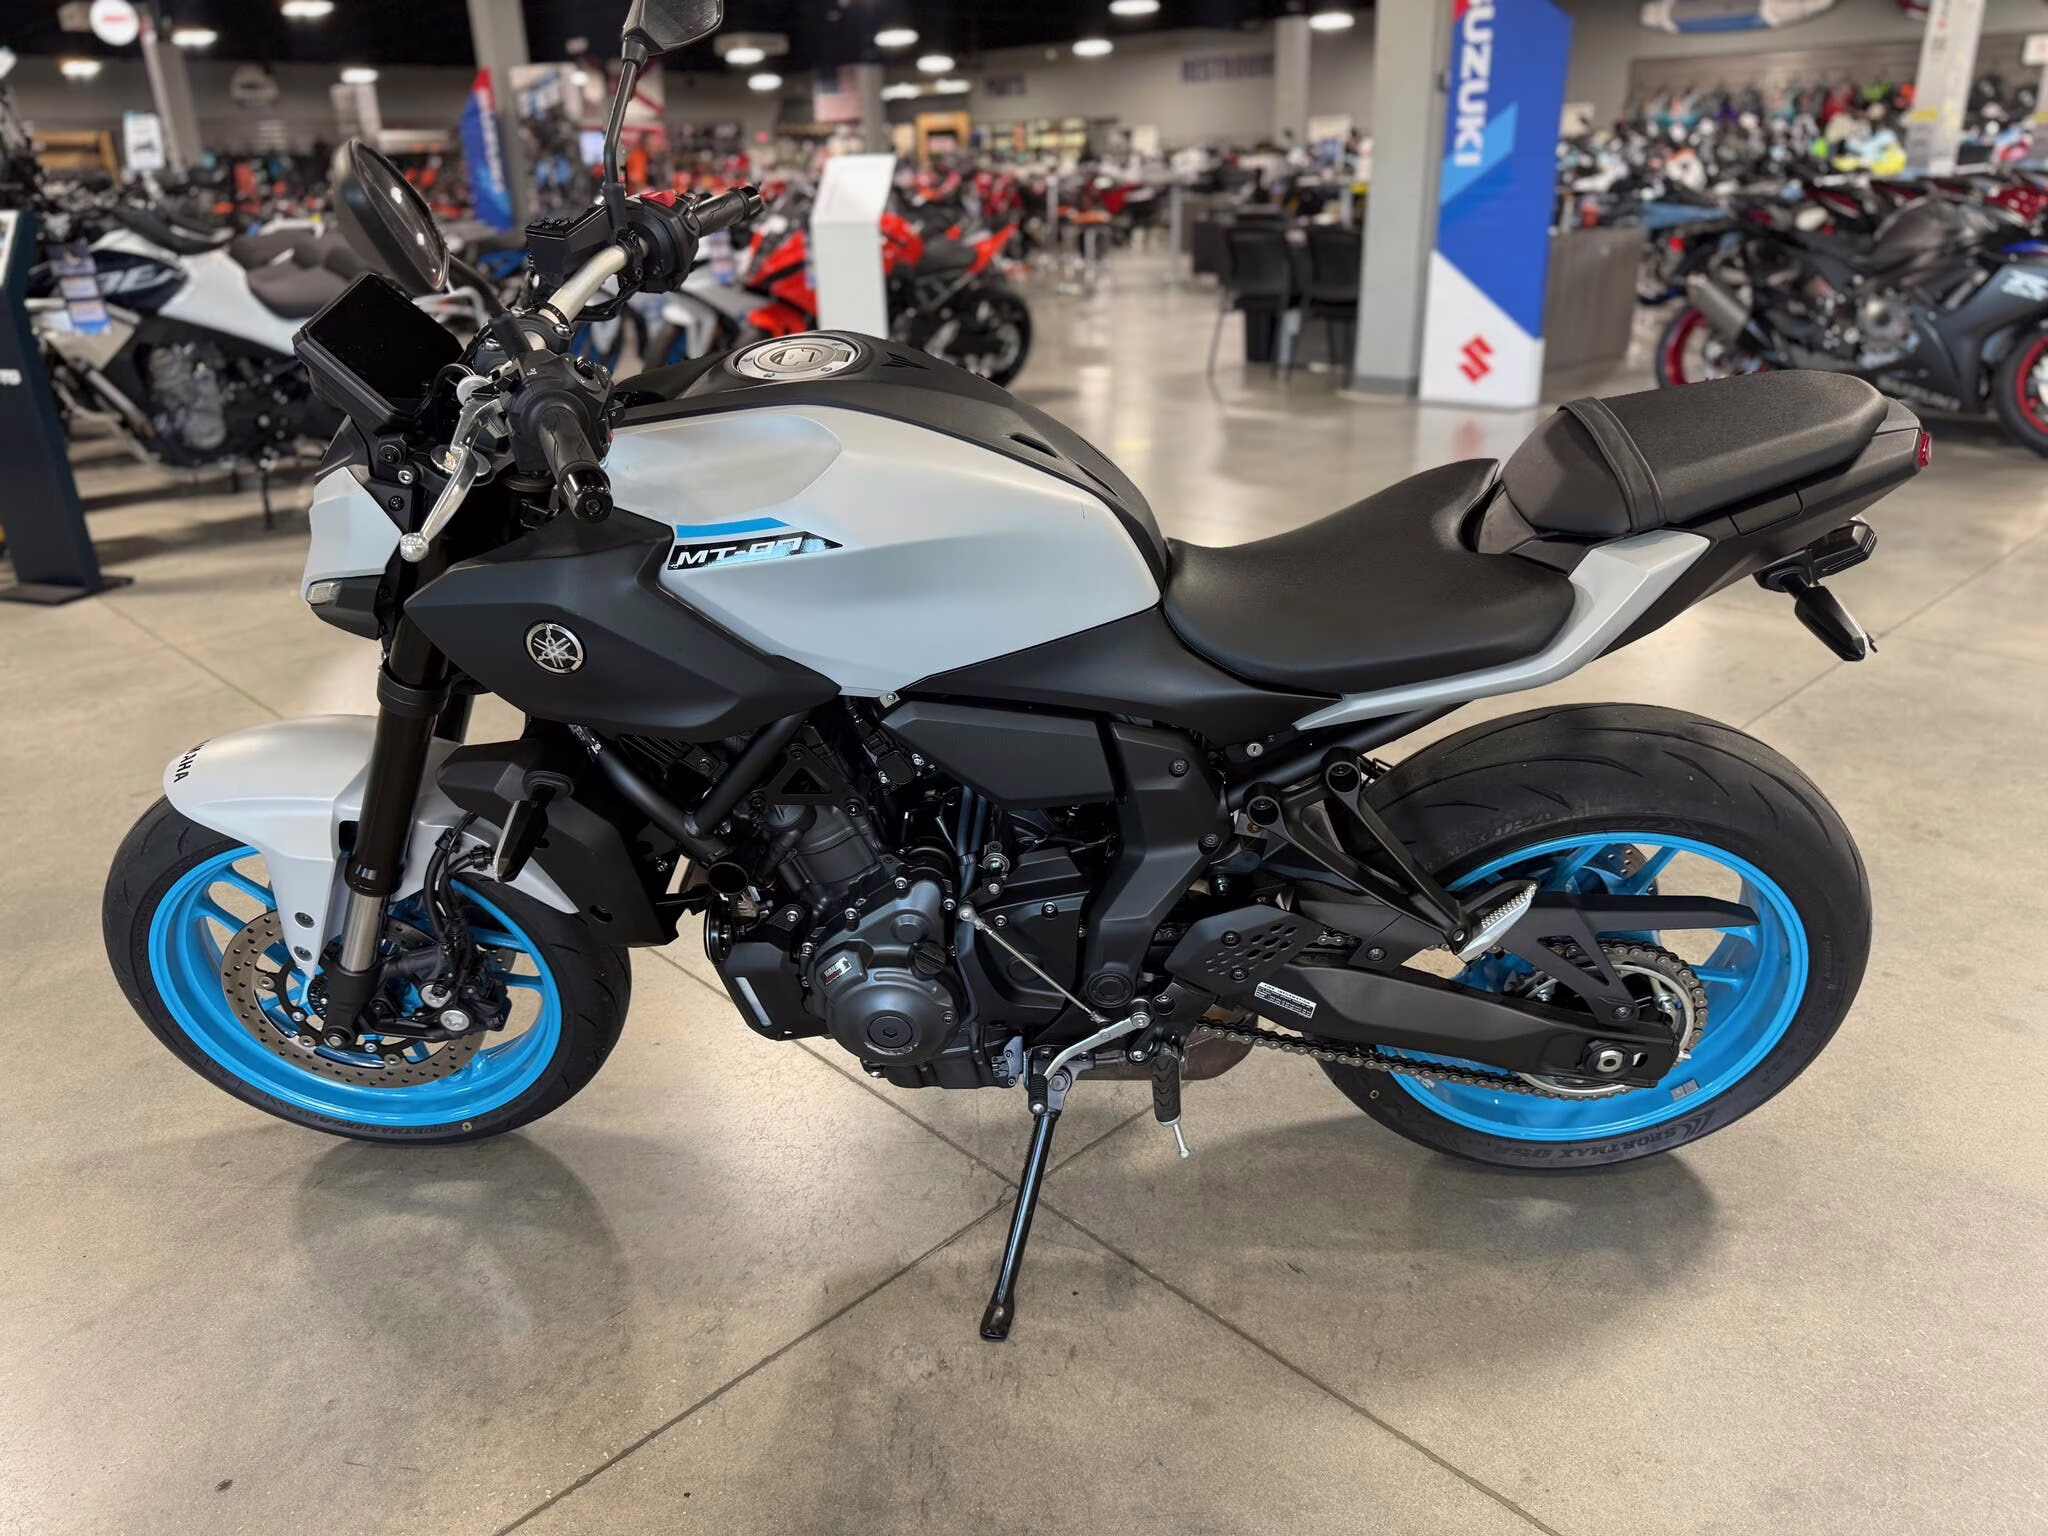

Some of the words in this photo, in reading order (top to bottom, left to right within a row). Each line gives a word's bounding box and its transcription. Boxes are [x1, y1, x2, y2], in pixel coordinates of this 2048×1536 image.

[1453, 0, 1496, 168] UZUKI
[676, 536, 803, 566] MT-07
[1559, 1125, 1678, 1159] SPORTMAX
